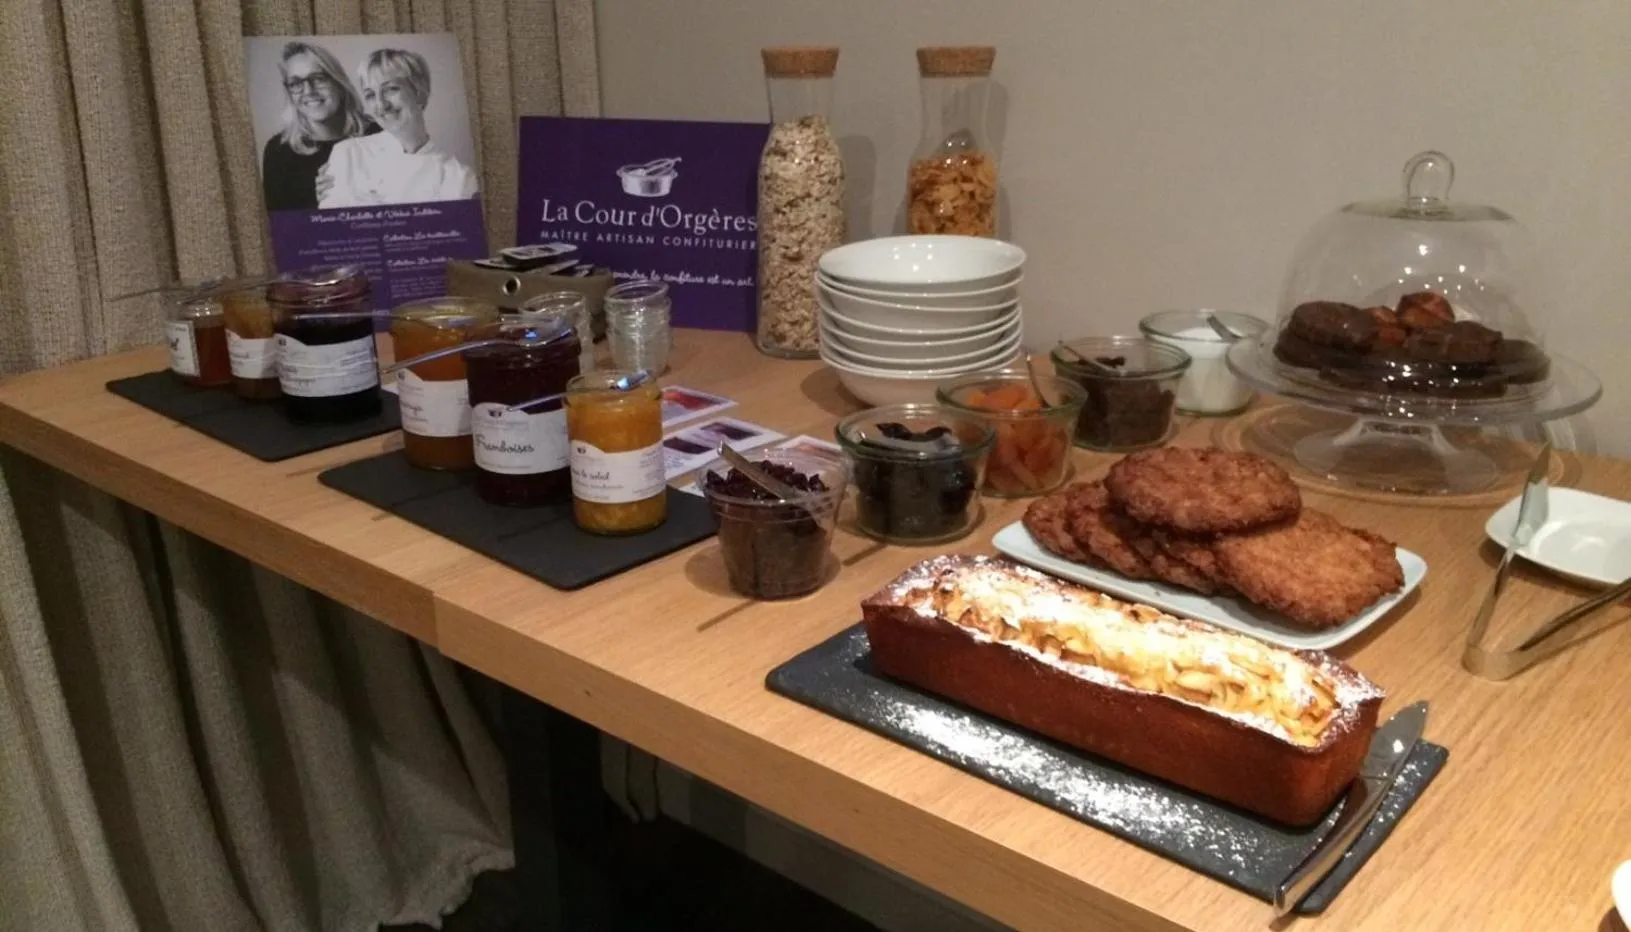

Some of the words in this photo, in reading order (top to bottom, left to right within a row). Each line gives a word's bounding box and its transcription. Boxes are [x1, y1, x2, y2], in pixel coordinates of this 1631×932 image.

[541, 198, 569, 224] La
[574, 199, 638, 227] Cour
[640, 203, 758, 234] d'Orgères
[540, 228, 589, 242] MAÎTRE
[596, 232, 655, 246] ARTISAN
[662, 235, 757, 251] CONFITURIER
[662, 269, 705, 285] confiture
[706, 273, 720, 285] est
[475, 432, 536, 454] Framboises
